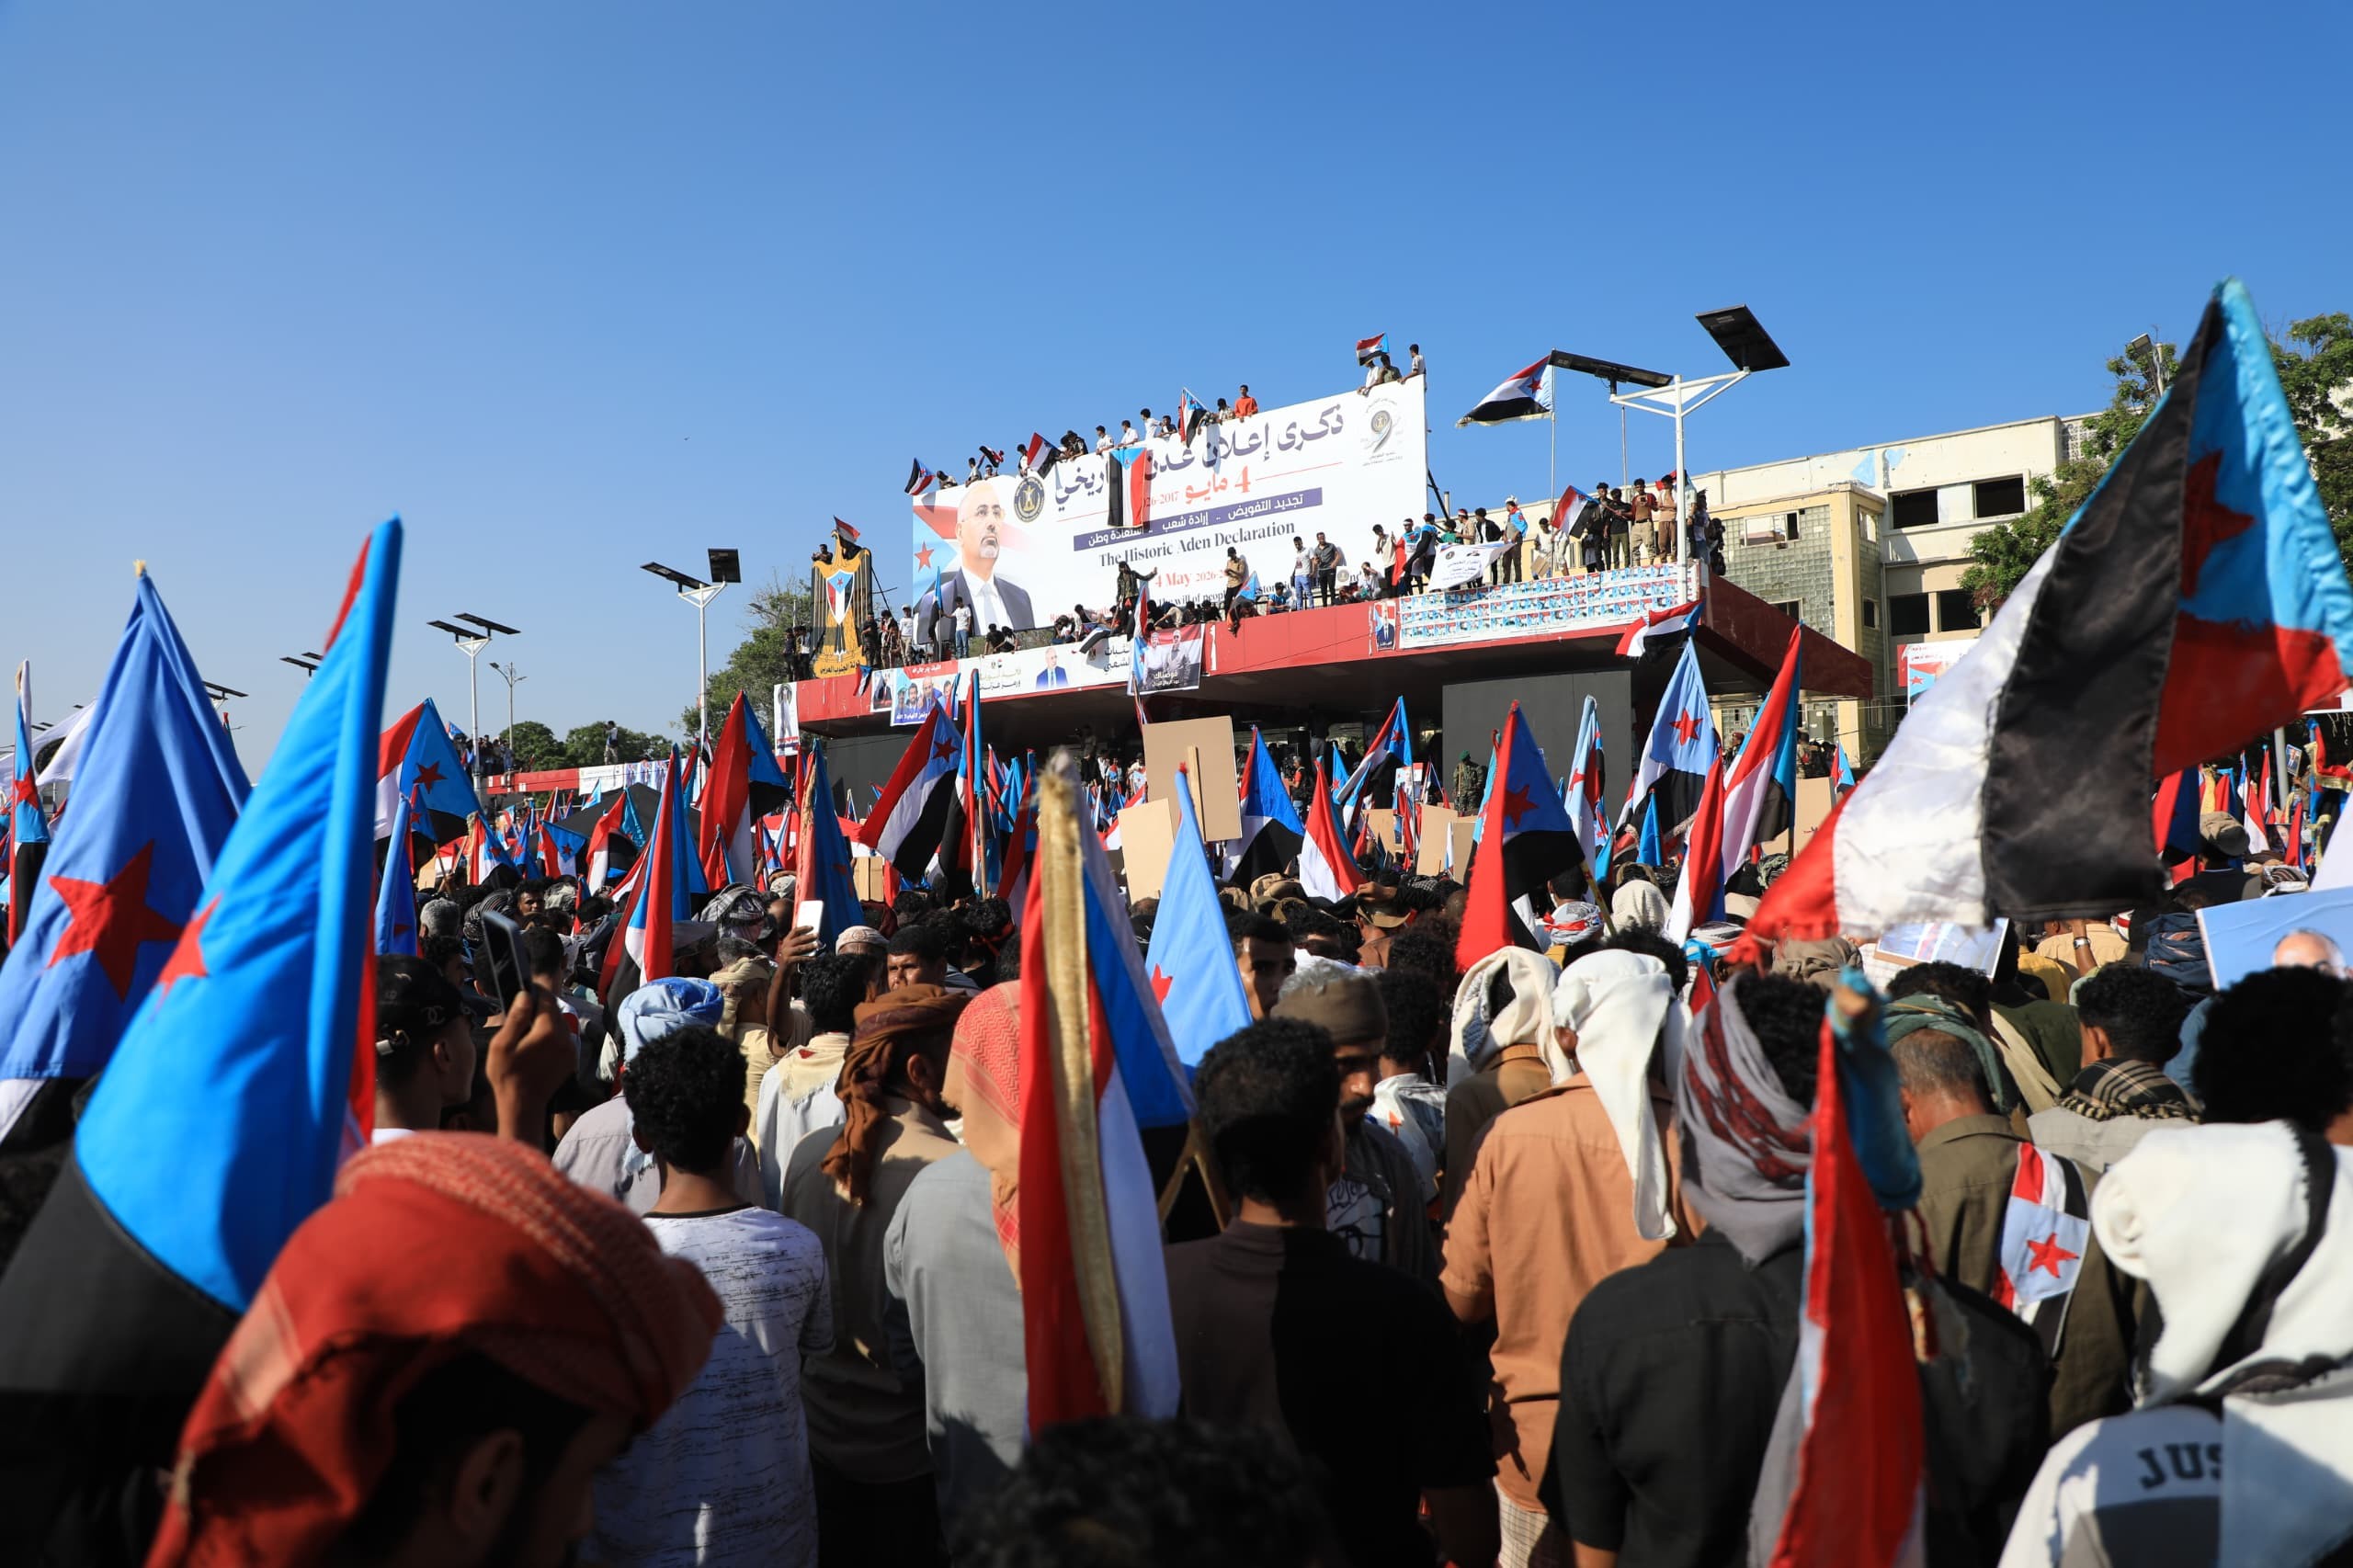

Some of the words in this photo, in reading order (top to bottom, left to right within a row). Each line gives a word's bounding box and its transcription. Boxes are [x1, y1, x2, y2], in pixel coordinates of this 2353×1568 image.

[1278, 403, 1344, 451] ذكرى
[1202, 422, 1269, 468] إعلان
[1144, 448, 1195, 481] عدن
[1185, 472, 1229, 505] مايو
[1234, 466, 1251, 494] 4
[1228, 499, 1272, 520] التفويض
[1274, 494, 1303, 510] تجديد
[1162, 516, 1187, 532] شعب
[1188, 512, 1209, 526] إرادة
[1088, 533, 1108, 546] وطن
[1099, 552, 1121, 567] The
[1124, 542, 1174, 563] Historic
[1176, 537, 1211, 554] Aden
[1214, 522, 1295, 547] Declaration
[1155, 575, 1162, 587] 4
[1165, 572, 1192, 587] May
[1203, 590, 1226, 603] peopl
